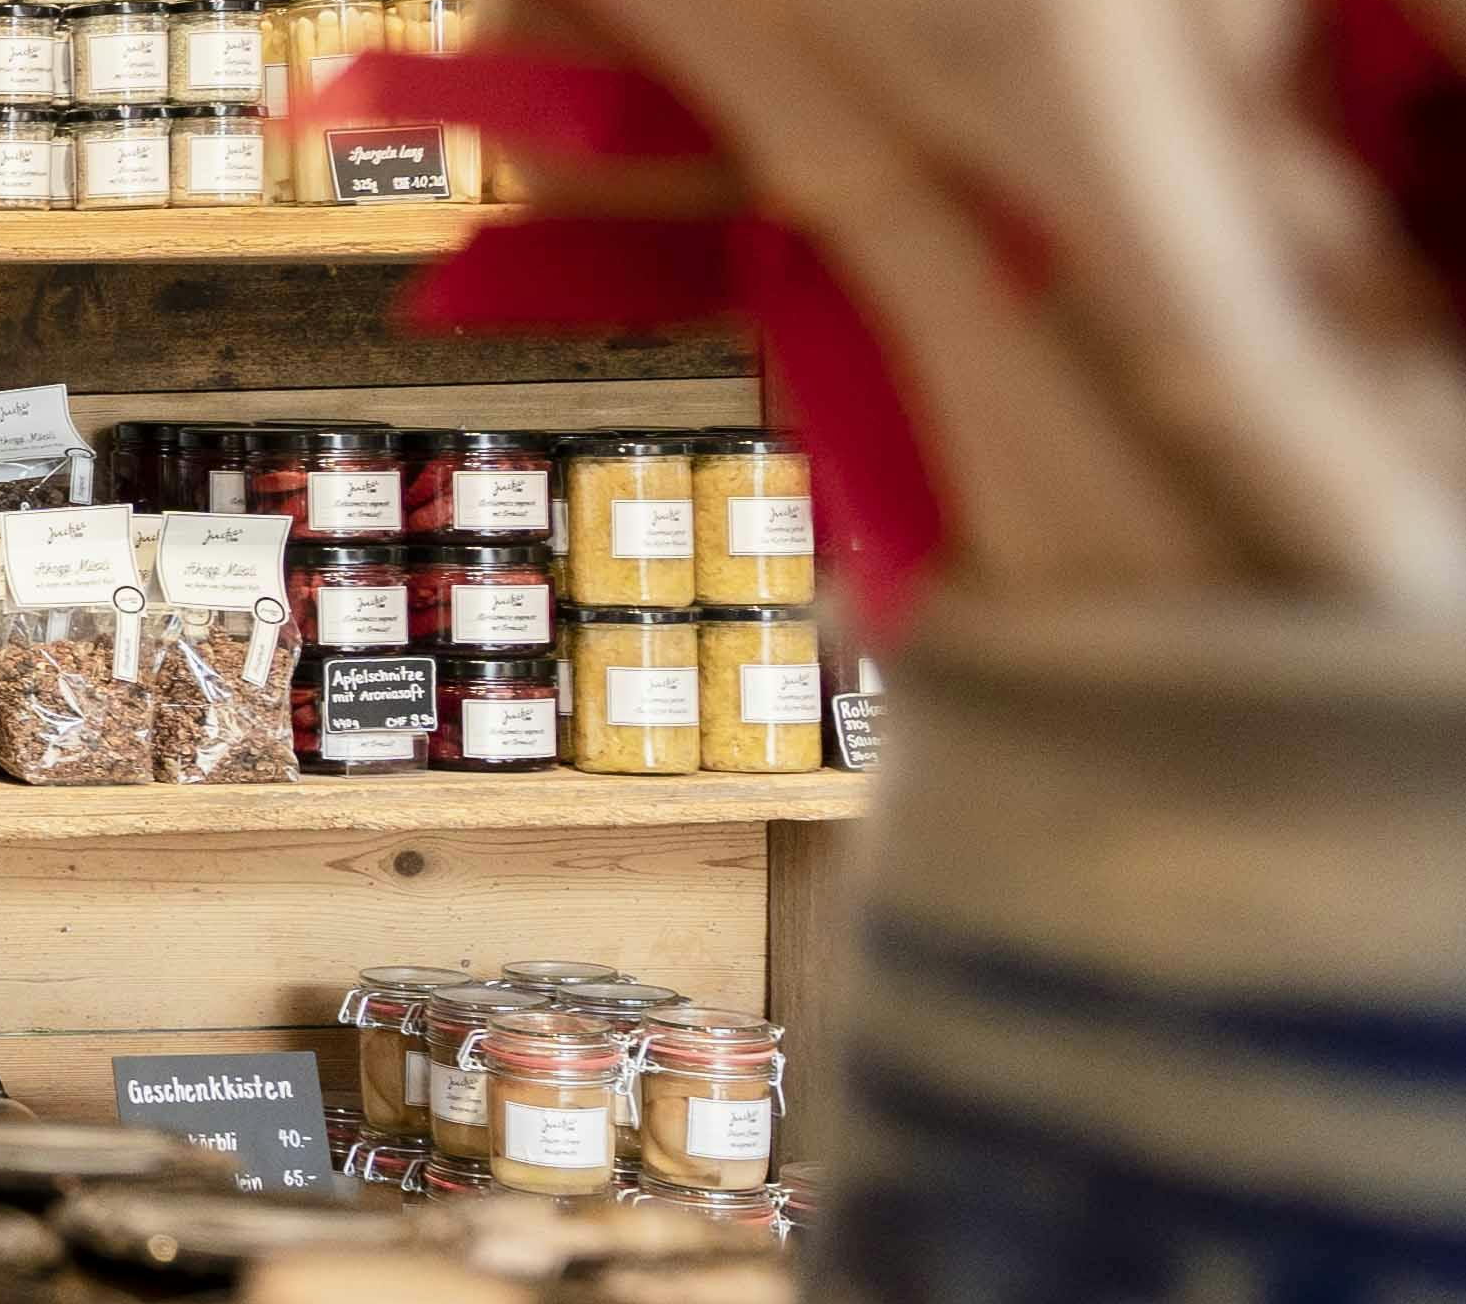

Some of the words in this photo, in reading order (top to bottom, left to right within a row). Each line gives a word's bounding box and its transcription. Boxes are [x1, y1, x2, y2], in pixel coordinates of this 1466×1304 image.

[332, 666, 426, 690] Apfelschnitze
[331, 691, 355, 703] mit
[359, 683, 426, 703] Aroniasaft
[385, 716, 407, 728] CHF
[128, 1075, 294, 1104] Geschenkkisten
[278, 1128, 313, 1148] 40.-
[283, 1169, 318, 1188] 65.-
